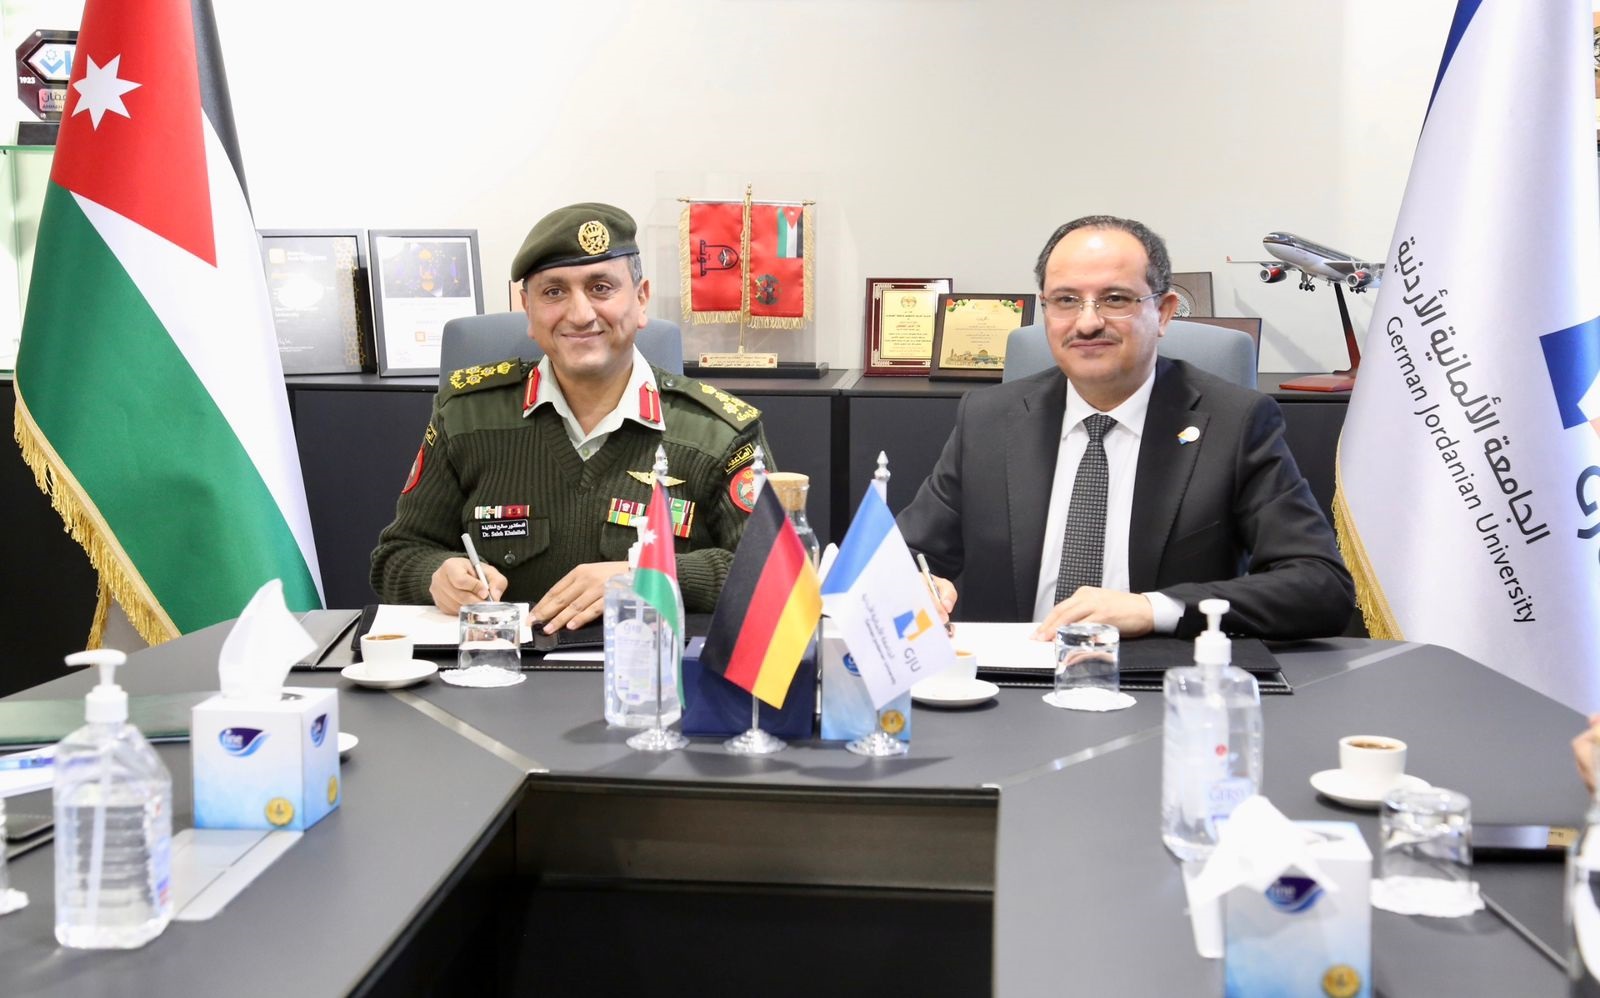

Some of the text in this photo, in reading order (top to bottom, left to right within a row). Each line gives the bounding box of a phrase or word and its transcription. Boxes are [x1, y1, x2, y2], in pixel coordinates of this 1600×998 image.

[1387, 316, 1536, 623] German Jordanian University
[1394, 236, 1551, 545] الجامعة الألمانية الأردنية
[903, 647, 921, 673] GJU
